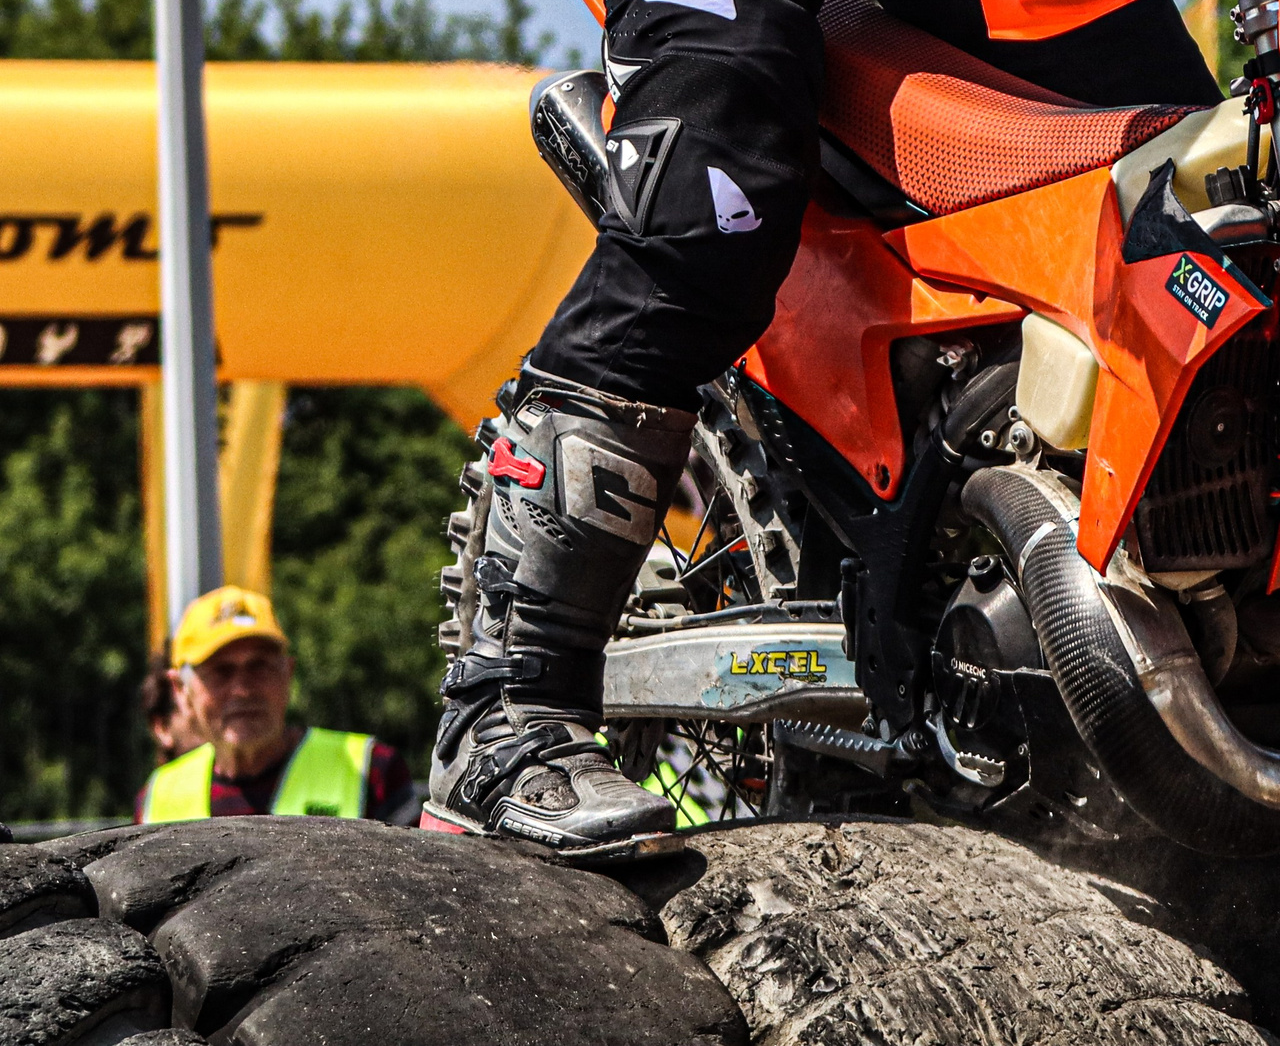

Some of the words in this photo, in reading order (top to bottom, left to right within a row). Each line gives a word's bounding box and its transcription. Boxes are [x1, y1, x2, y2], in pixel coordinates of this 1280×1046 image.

[1172, 257, 1227, 311] X-GRIP
[1172, 284, 1186, 299] STAY
[1183, 295, 1193, 306] ON
[1191, 301, 1210, 321] TRACK
[958, 660, 988, 679] NICECNC
